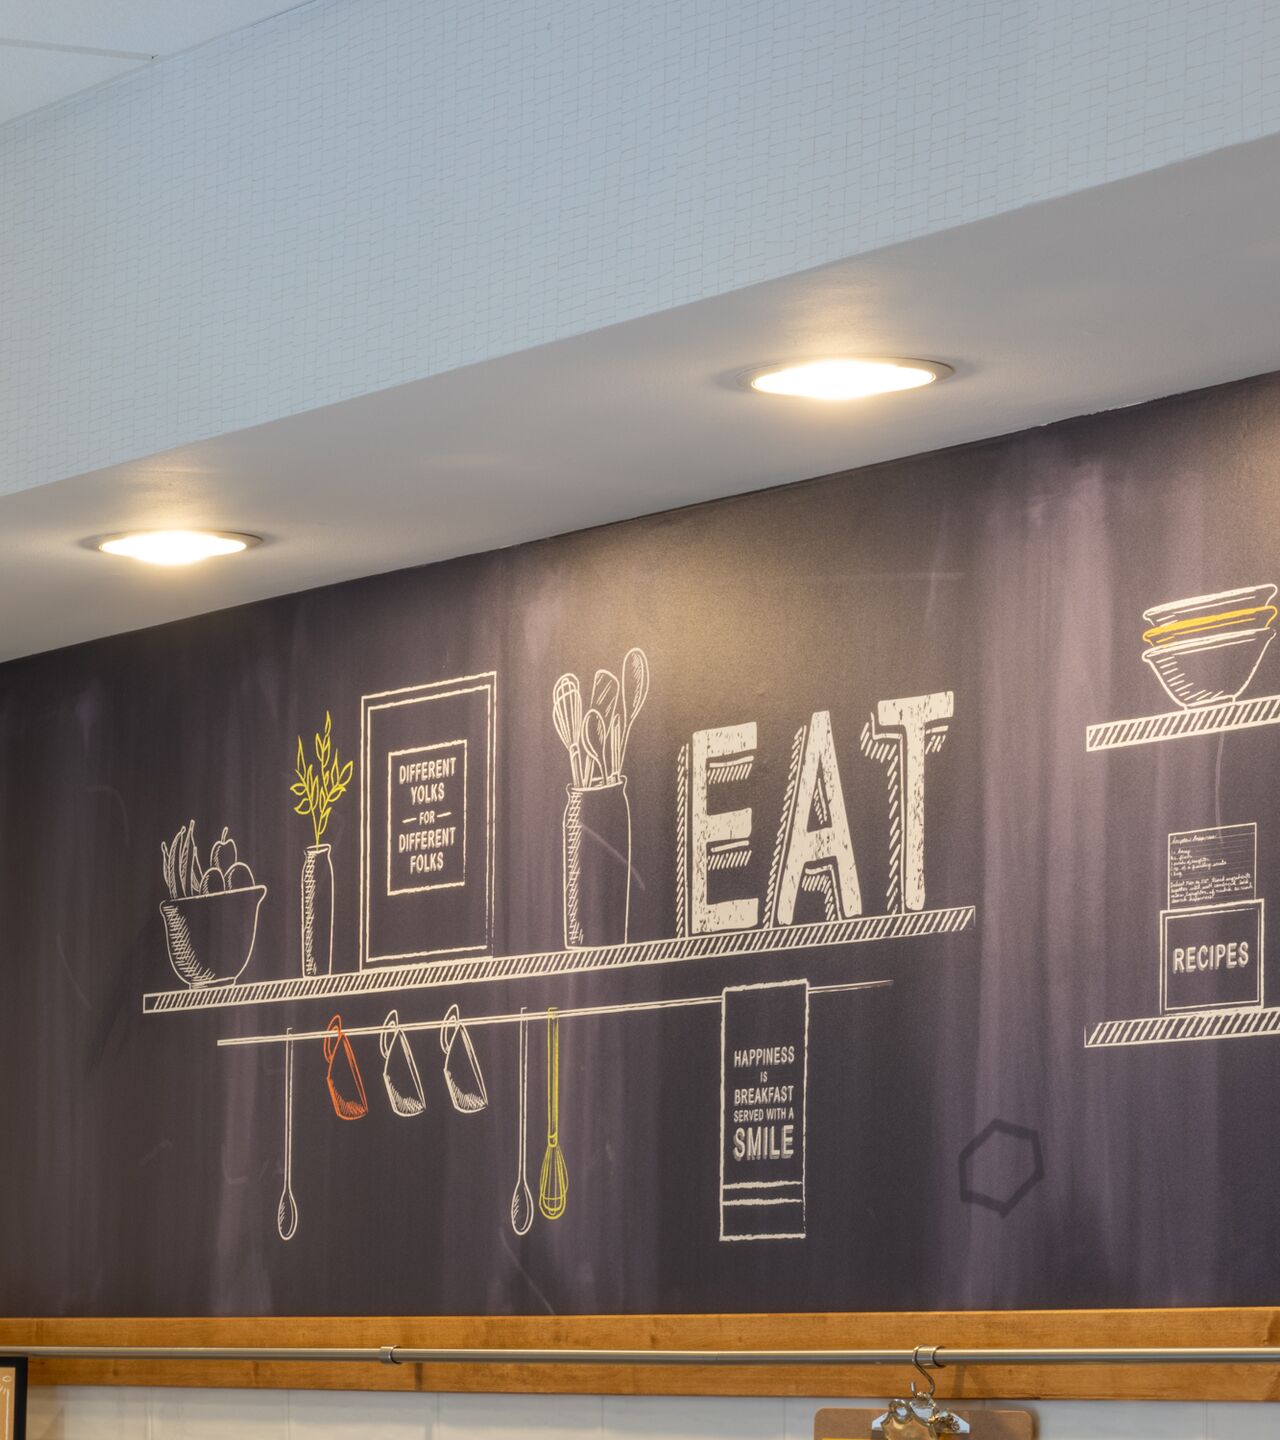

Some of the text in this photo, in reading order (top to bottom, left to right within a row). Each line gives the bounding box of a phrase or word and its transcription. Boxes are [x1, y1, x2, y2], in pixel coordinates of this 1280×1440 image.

[399, 757, 457, 785] DIFFERENT
[410, 782, 445, 805] YOLKS
[419, 810, 435, 825] FOR
[677, 690, 954, 938] EAT
[398, 827, 456, 853] DIFFERENT
[410, 852, 444, 874] FOLKS
[1173, 941, 1249, 974] RECIPES
[734, 1046, 795, 1068] HAPPINESS
[760, 1071, 768, 1084] IS
[734, 1085, 794, 1106] BREAKFAST
[733, 1106, 794, 1123] SERVED WITH A
[733, 1125, 794, 1161] SMILE
